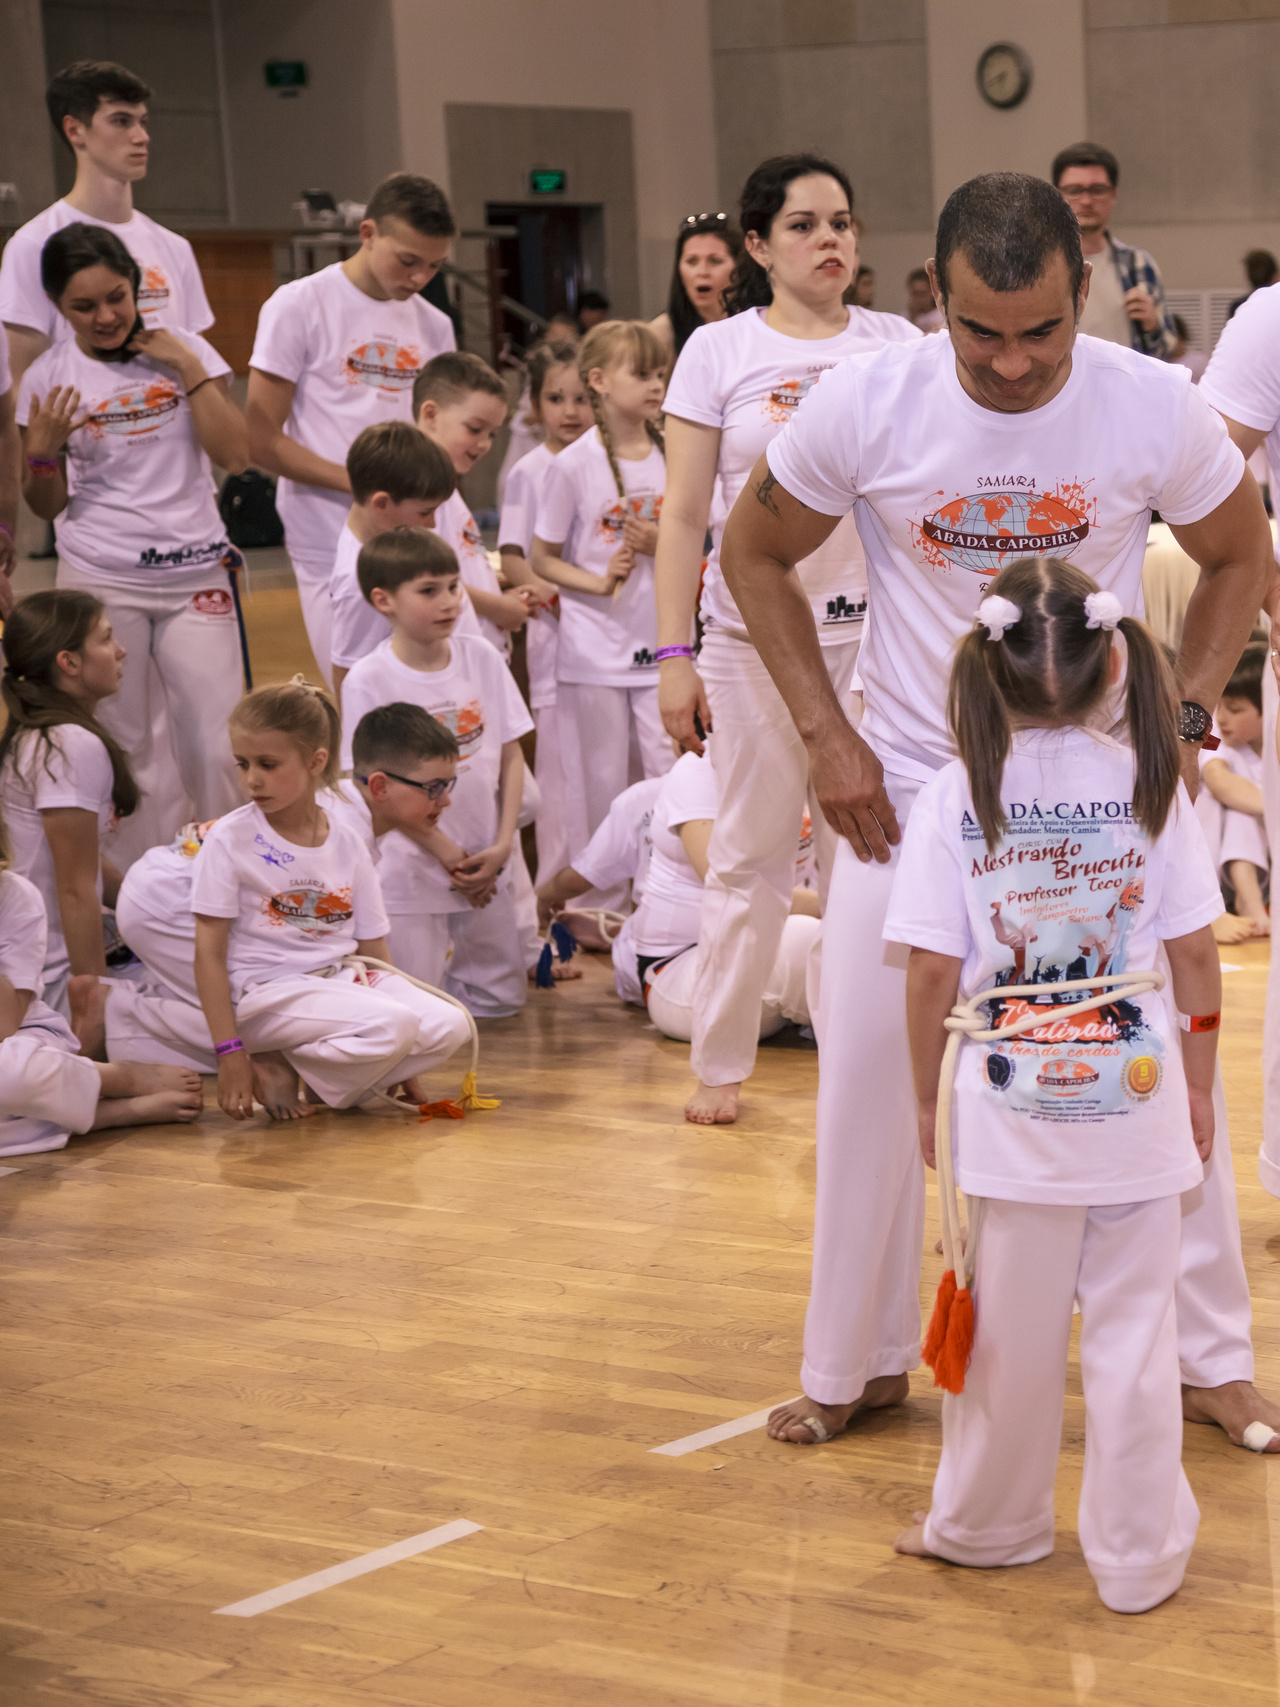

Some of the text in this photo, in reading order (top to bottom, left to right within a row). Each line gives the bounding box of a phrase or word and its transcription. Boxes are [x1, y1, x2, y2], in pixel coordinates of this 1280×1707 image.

[976, 474, 1037, 489] SAMARA
[931, 529, 1081, 551] ABADÁ-CAPOEIRA
[1040, 819, 1059, 829] Apoio
[1044, 825, 1070, 835] Mestre
[1071, 826, 1101, 834] Camisa
[971, 837, 1082, 878] Mestrando
[1005, 877, 1123, 906] Professor Teco
[1041, 1045, 1061, 1057] de
[1067, 1045, 1120, 1057] cordas
